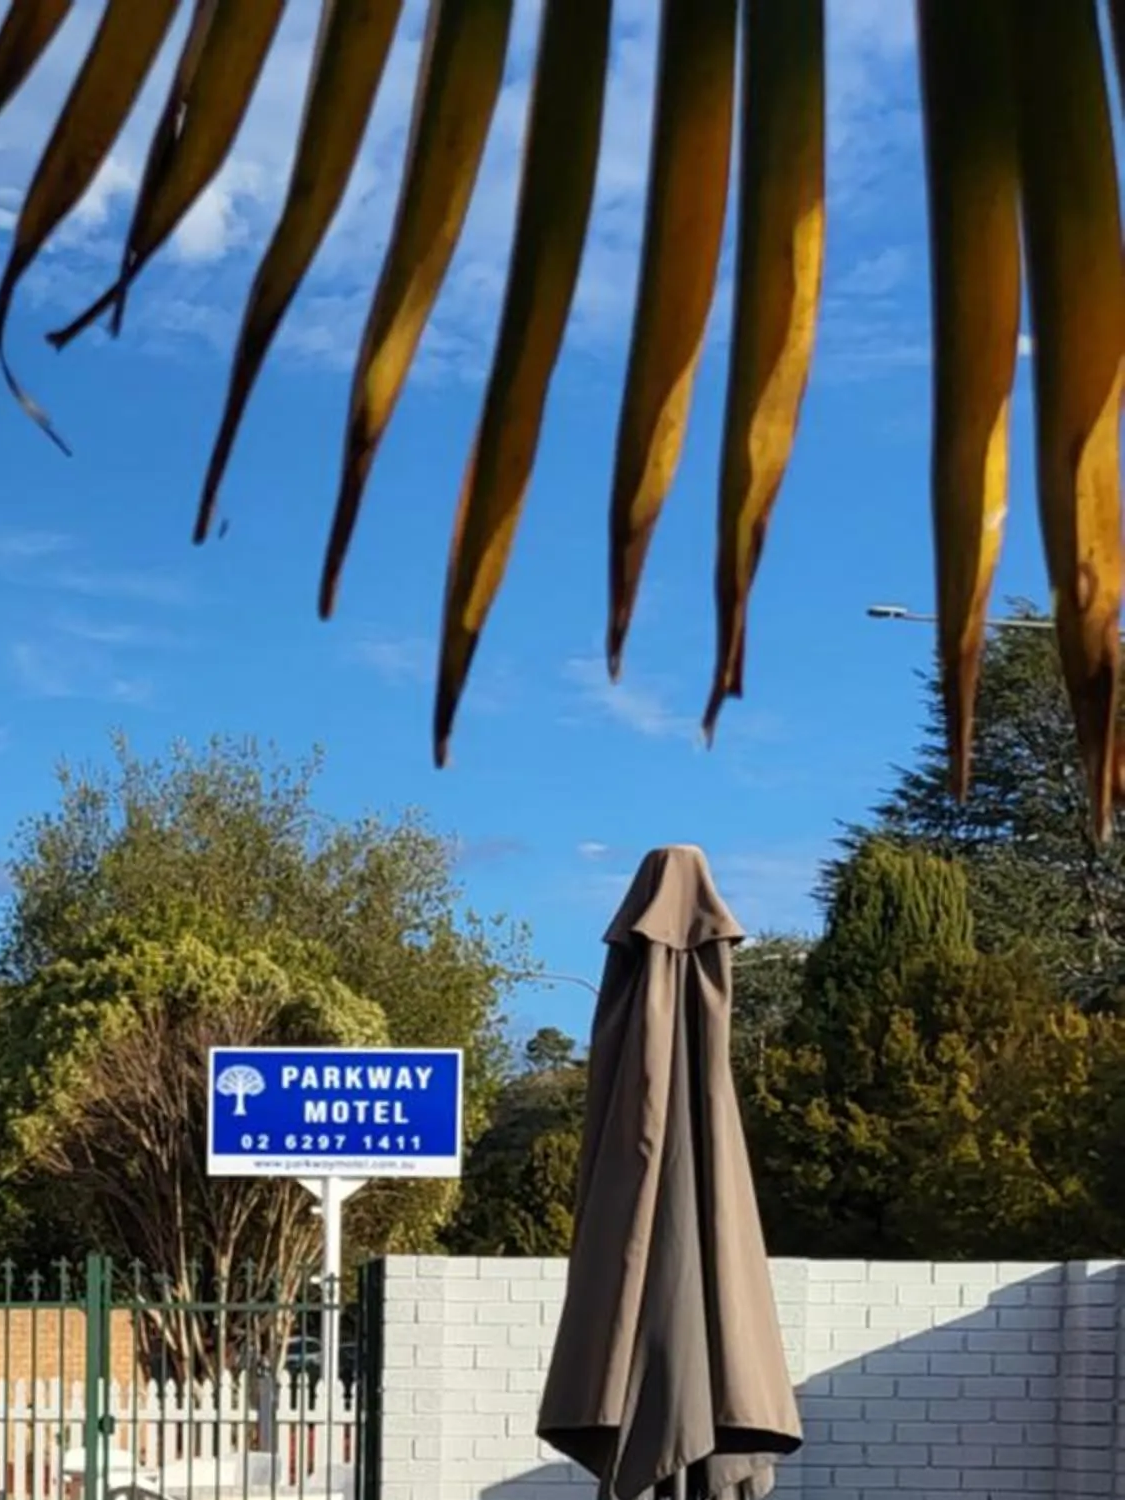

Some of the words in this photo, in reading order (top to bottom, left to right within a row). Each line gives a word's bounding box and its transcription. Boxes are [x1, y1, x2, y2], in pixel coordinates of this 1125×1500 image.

[281, 1065, 433, 1090] PARKWAY
[303, 1099, 409, 1124] MOTEL
[240, 1134, 270, 1150] 02
[284, 1134, 346, 1150] 6297
[363, 1135, 421, 1150] 1411
